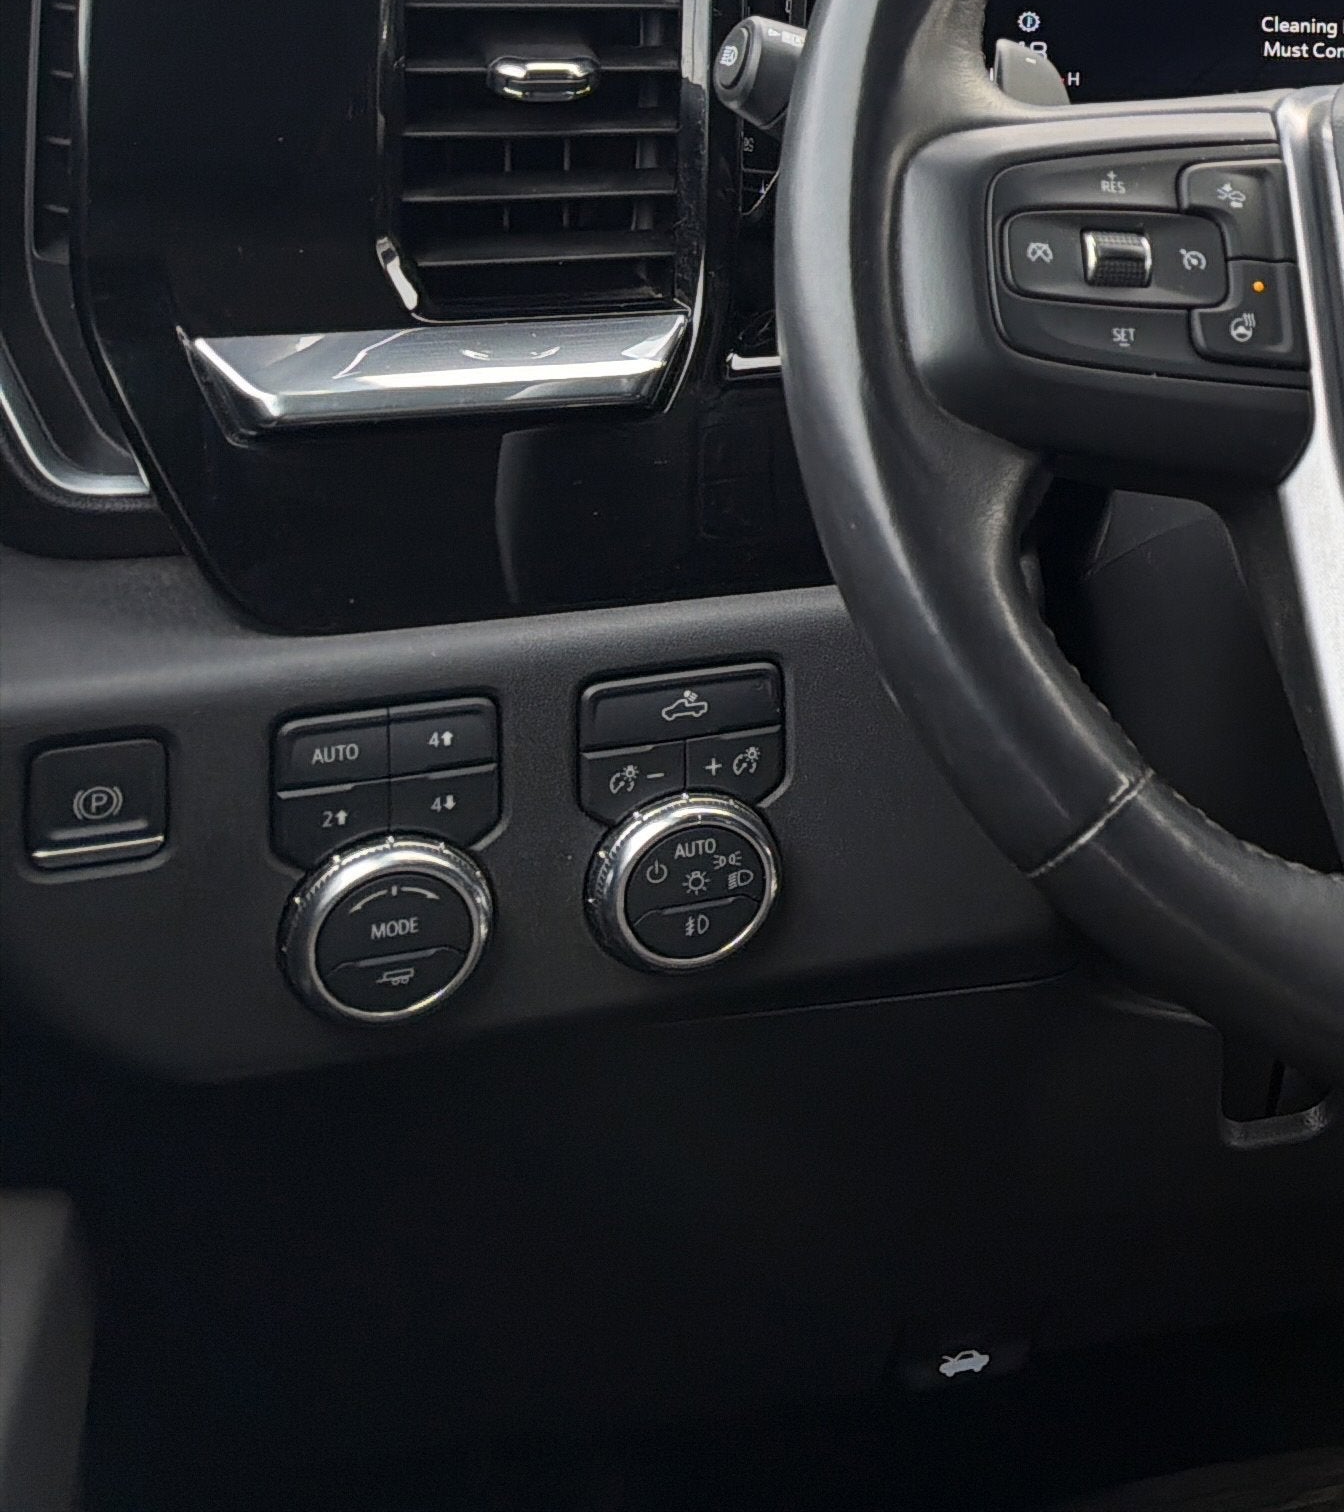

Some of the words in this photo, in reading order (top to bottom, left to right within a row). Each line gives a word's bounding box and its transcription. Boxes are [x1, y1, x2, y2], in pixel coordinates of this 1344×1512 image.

[1261, 15, 1338, 38] Cleaning
[1263, 40, 1309, 58] Must
[1067, 72, 1080, 86] H
[1101, 180, 1126, 194] RES
[1112, 328, 1136, 342] SET
[428, 732, 439, 748] 4
[311, 743, 360, 765] AUTO
[430, 797, 442, 813] 4
[322, 811, 333, 828] 2
[674, 837, 717, 860] AUTO
[371, 916, 419, 940] MODE
